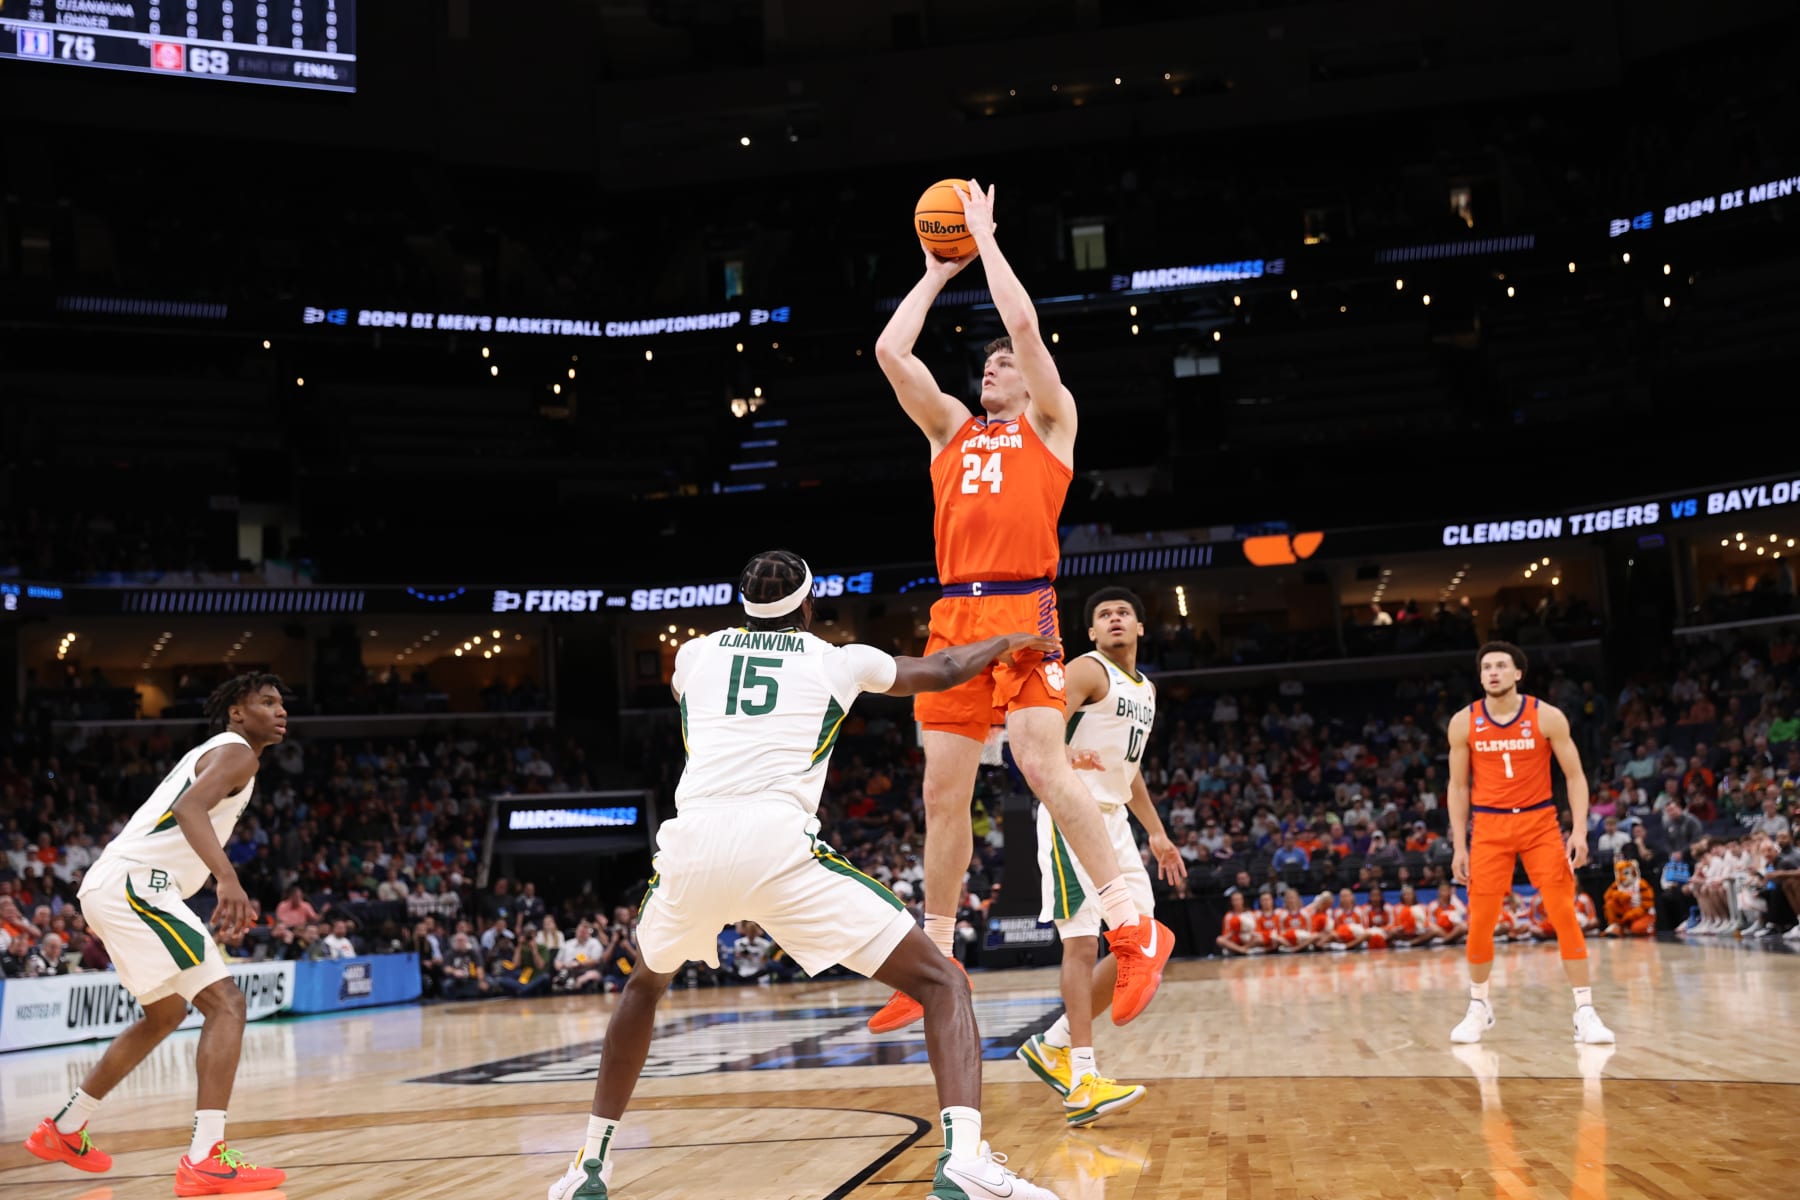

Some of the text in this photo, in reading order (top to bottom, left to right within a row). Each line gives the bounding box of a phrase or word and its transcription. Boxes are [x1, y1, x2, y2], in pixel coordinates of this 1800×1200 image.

[189, 48, 229, 75] 63
[293, 62, 338, 80] FINAL
[1664, 196, 1715, 224] 2024
[1720, 189, 1744, 211] DI
[919, 220, 966, 234] Wilson
[357, 310, 741, 337] 2024 DI MEN'S BASKETBALL CHAMPIONSHIP
[961, 452, 1003, 494] 24
[1442, 517, 1562, 546] CLEMSON
[1568, 503, 1660, 535] TIGERS
[1670, 499, 1698, 519] VS
[524, 589, 604, 612] FIRST
[630, 583, 732, 612] SECOND
[972, 582, 982, 596] C
[718, 633, 805, 653] OJIANWUNA
[725, 654, 784, 716] 15
[1124, 725, 1144, 763] 10
[1474, 738, 1536, 753] CLEMSON
[1501, 752, 1514, 778] 1
[236, 972, 284, 1007] MPHIS
[67, 984, 145, 1028] UNIVER
